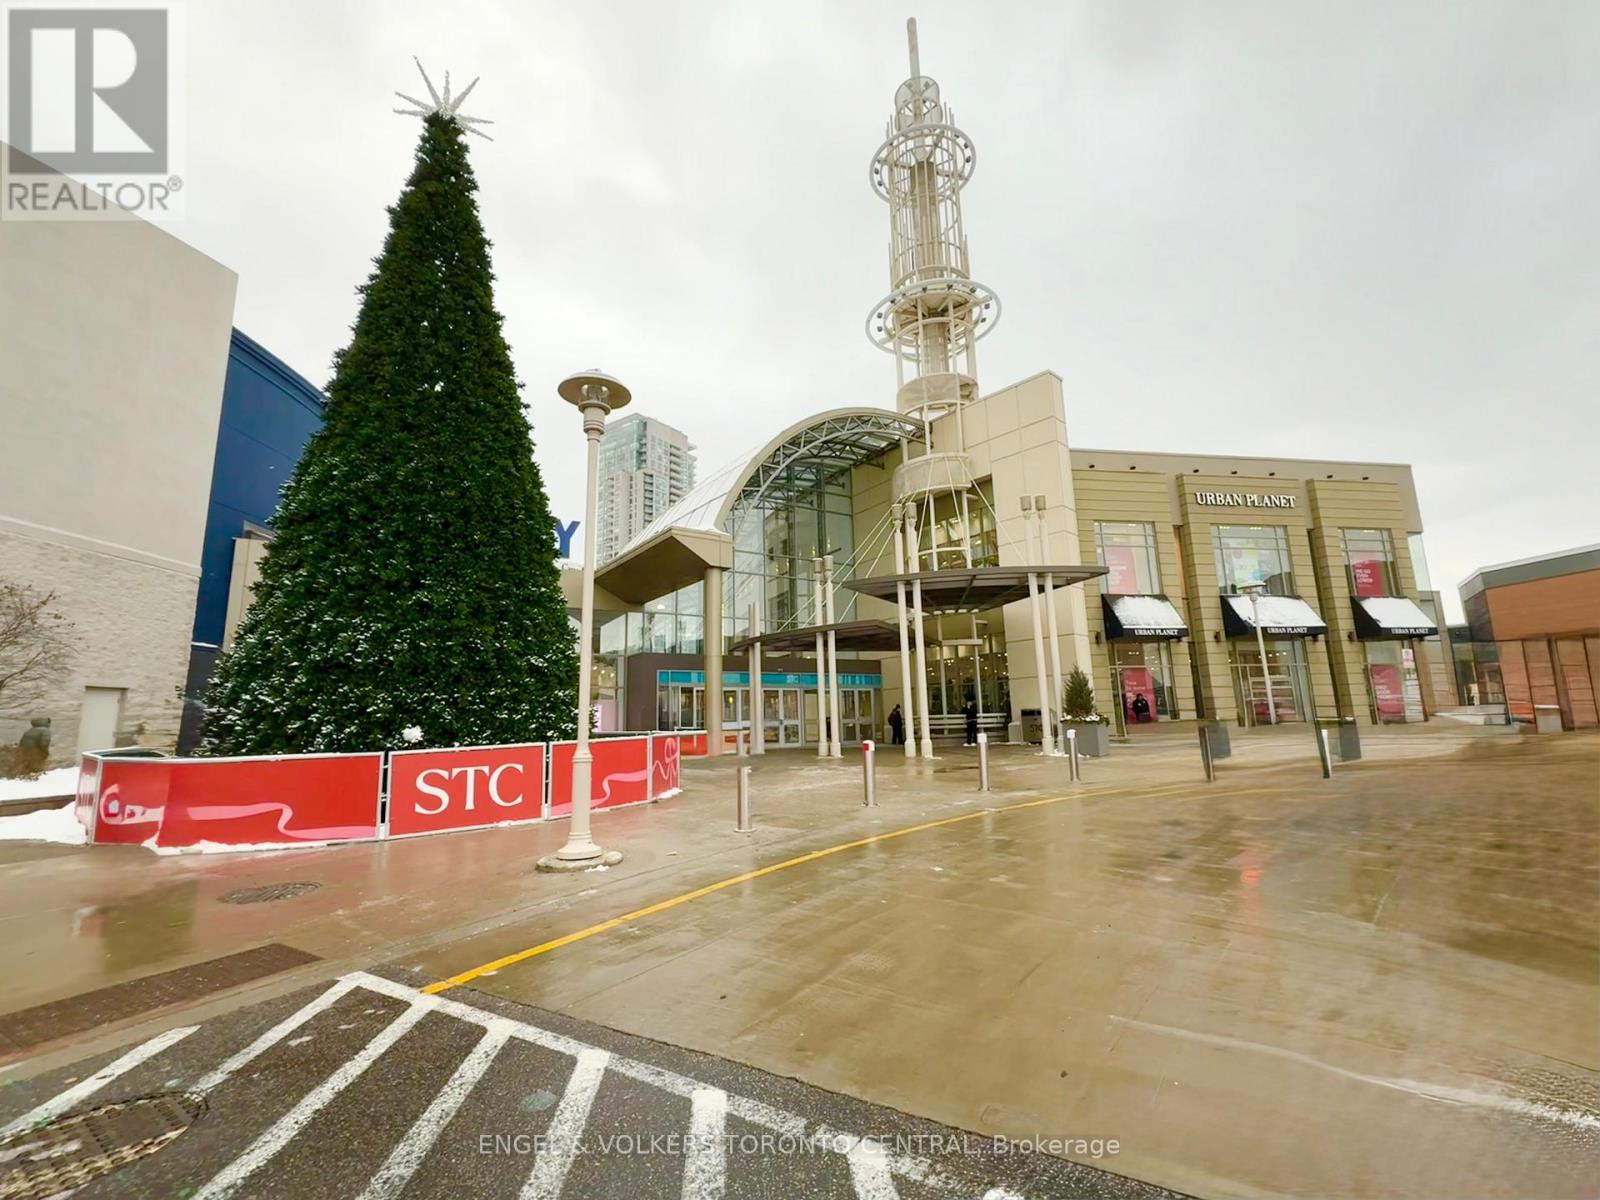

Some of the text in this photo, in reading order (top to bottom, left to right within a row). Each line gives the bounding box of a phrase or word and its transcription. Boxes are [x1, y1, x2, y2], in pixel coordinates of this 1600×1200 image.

[1195, 492, 1297, 508] URBAN PLANET
[414, 763, 524, 815] STC
